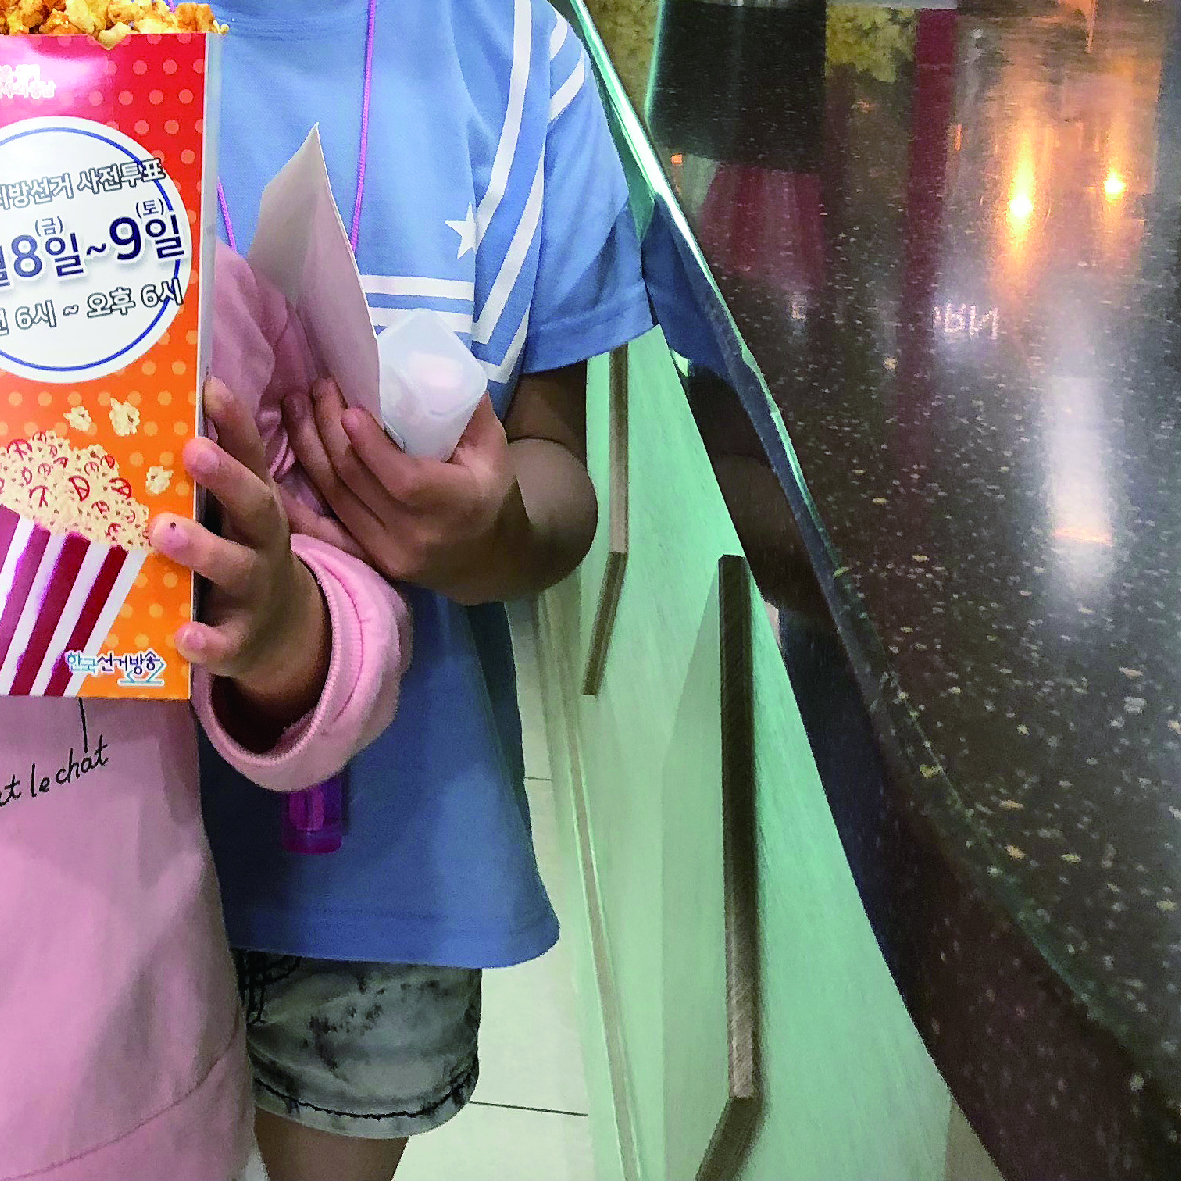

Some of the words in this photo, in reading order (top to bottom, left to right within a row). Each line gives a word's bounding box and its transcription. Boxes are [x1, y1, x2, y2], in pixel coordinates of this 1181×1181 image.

[76, 158, 167, 195] 사전투표
[15, 301, 57, 330] 6시
[86, 287, 136, 318] 오후
[140, 278, 184, 307] 6시
[66, 650, 162, 676] 한국선거방송
[30, 764, 51, 798] le
[55, 734, 110, 784] chat
